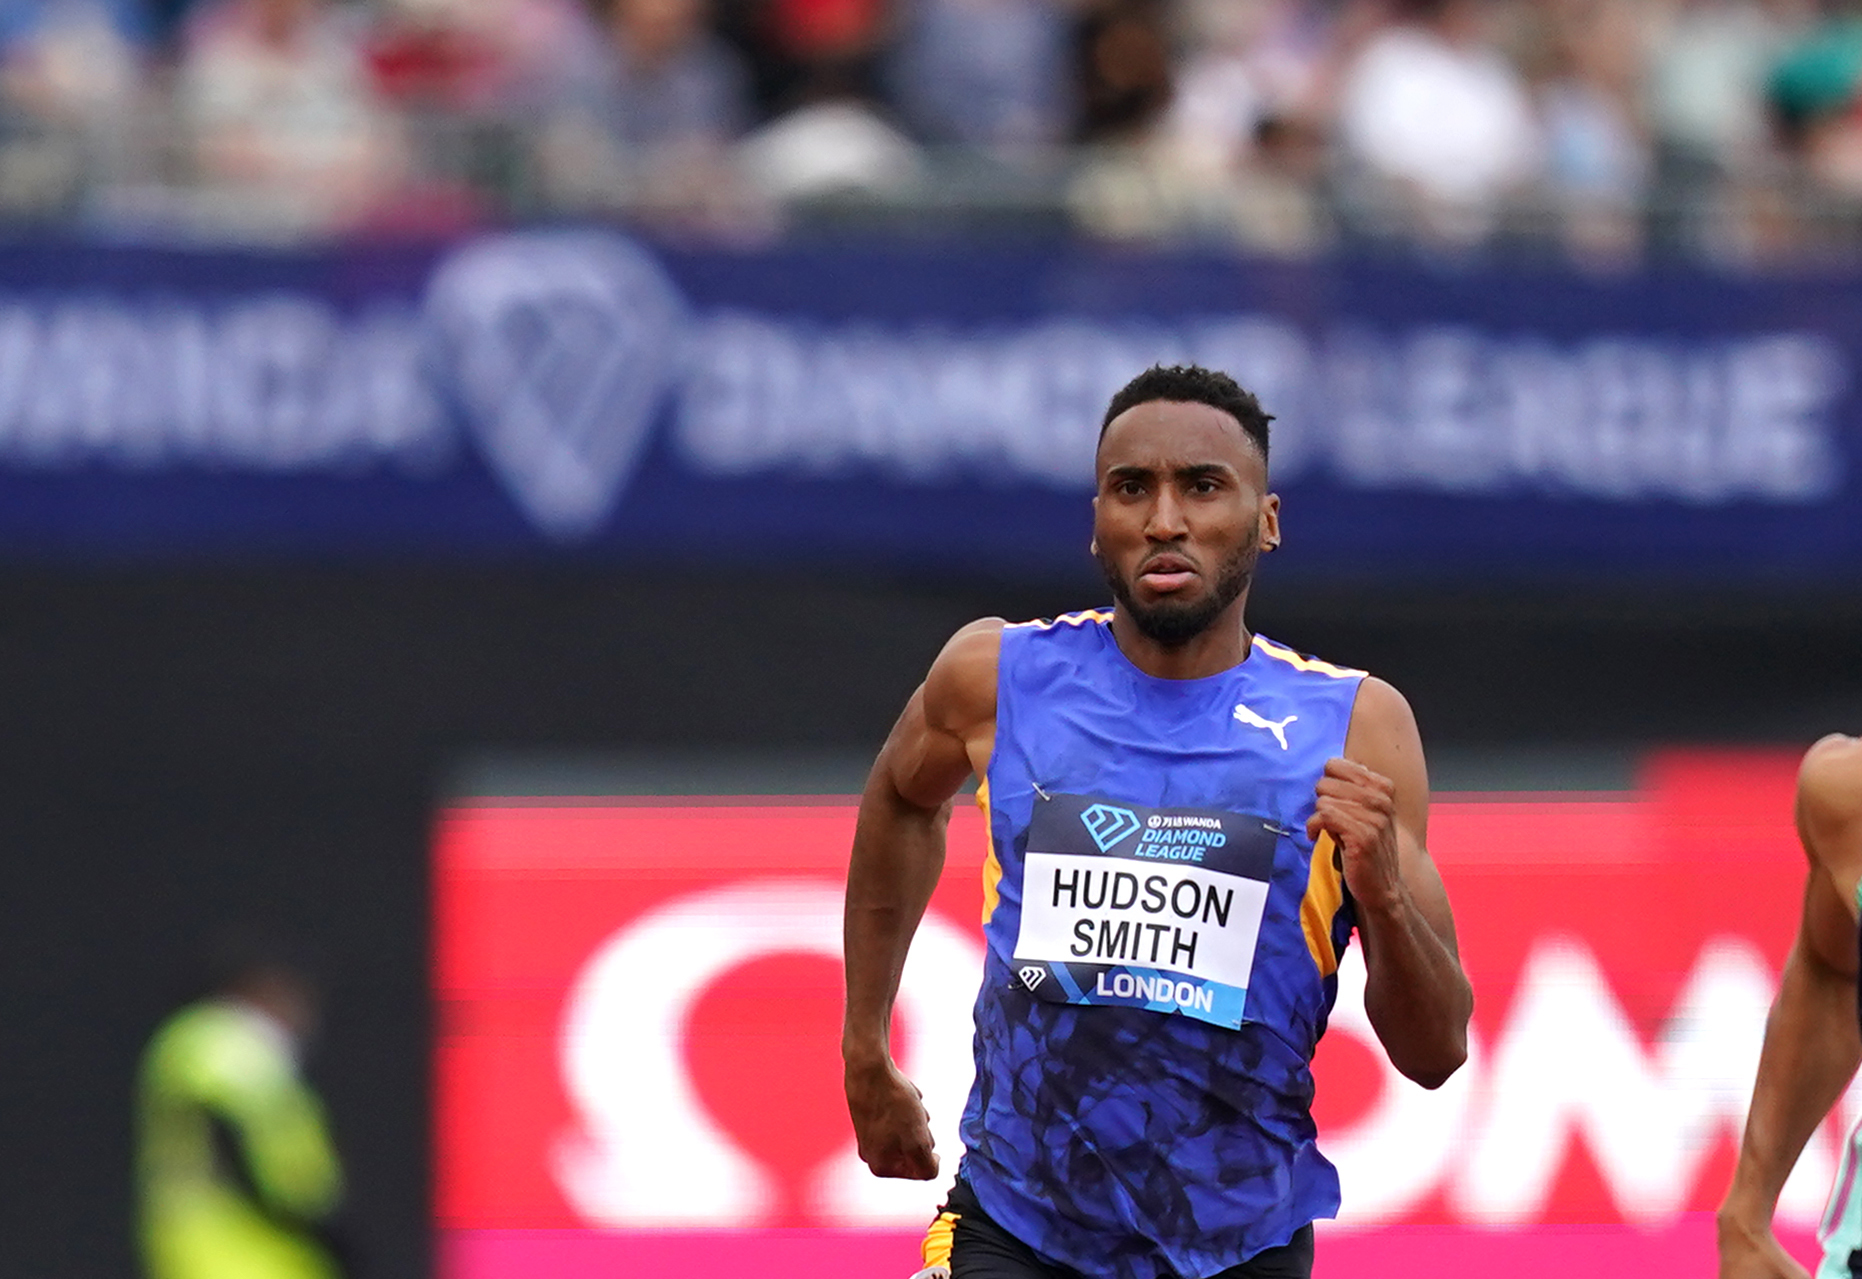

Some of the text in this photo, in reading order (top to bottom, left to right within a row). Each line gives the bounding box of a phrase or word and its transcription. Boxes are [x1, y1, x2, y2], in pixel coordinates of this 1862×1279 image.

[0, 304, 455, 478] ANDA
[1135, 843, 1206, 862] LEAGUE
[1142, 828, 1226, 848] DIAMOND
[1052, 868, 1234, 928] HUDSON
[1070, 918, 1199, 969] SMITH
[1096, 971, 1215, 1012] LONDON
